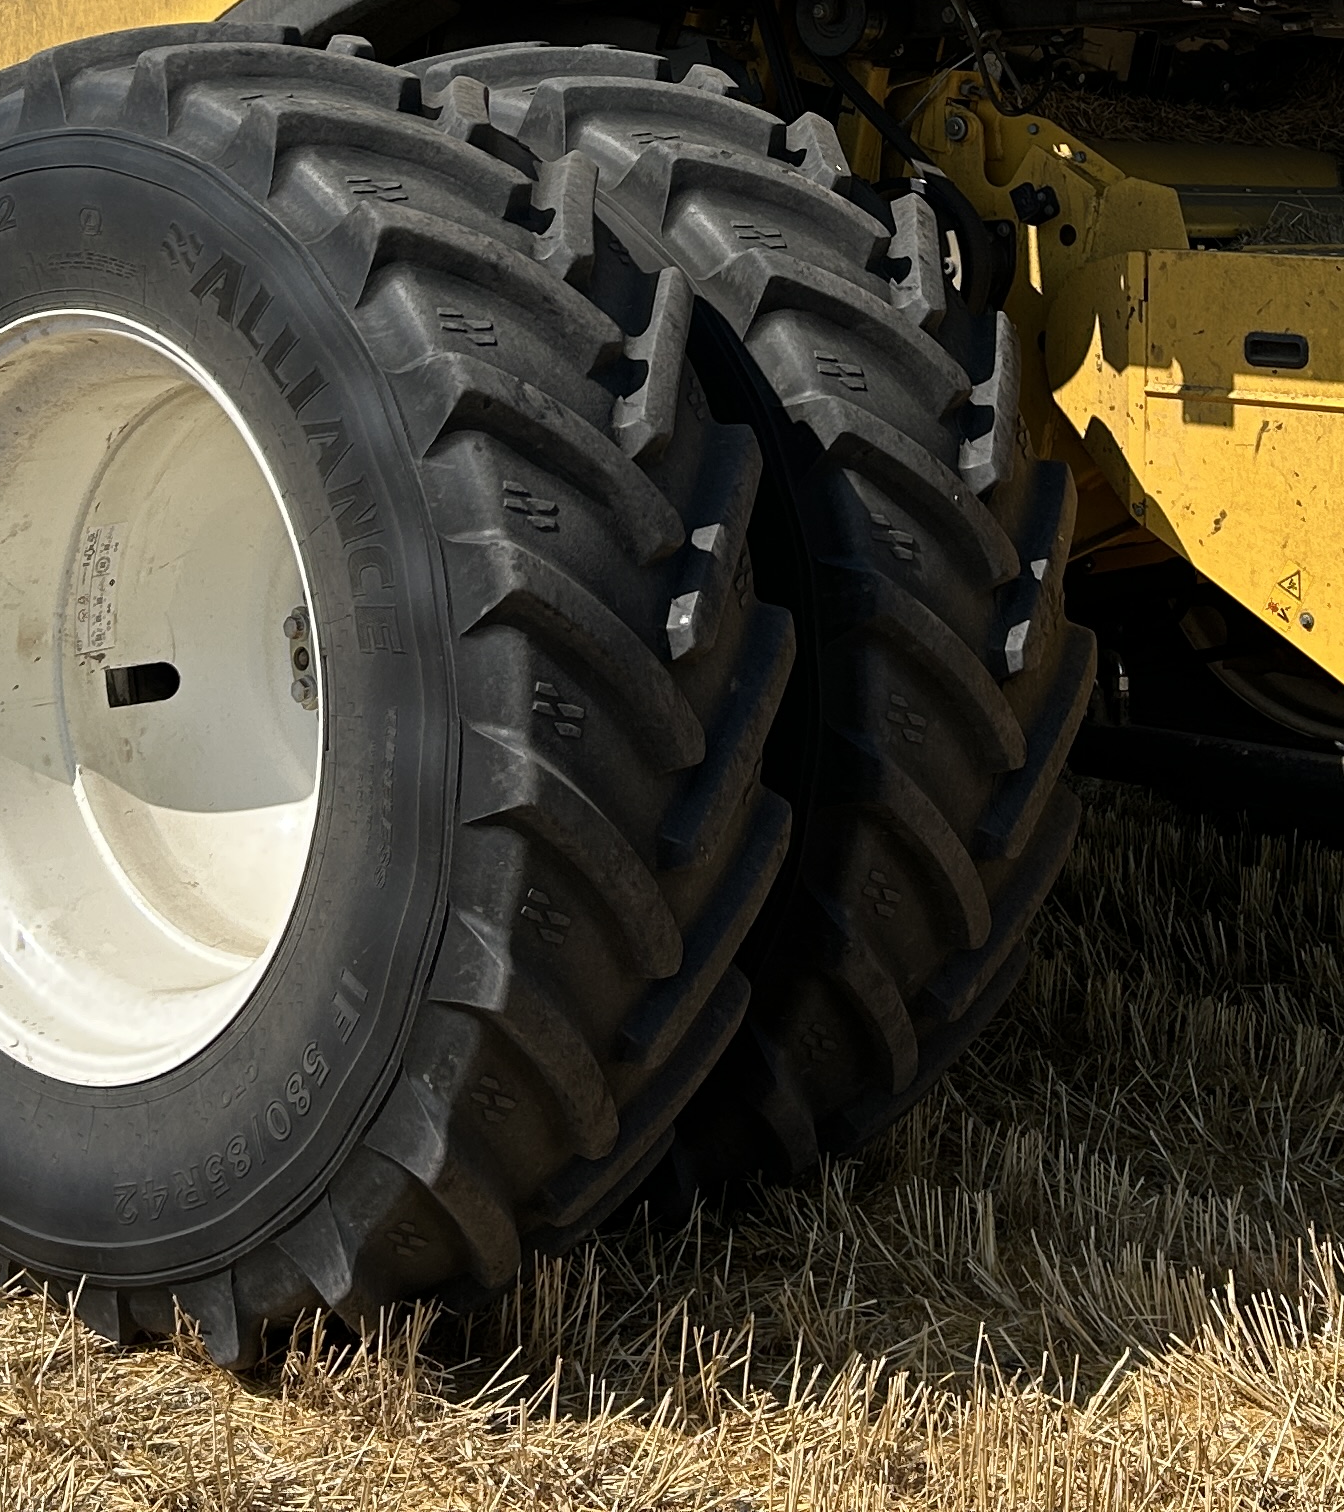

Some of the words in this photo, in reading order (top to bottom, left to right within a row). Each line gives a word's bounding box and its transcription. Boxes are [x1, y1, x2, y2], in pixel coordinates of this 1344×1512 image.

[189, 246, 408, 655] ALLIANCE
[332, 968, 369, 1044] IF
[113, 1040, 330, 1226] 580/85R42
